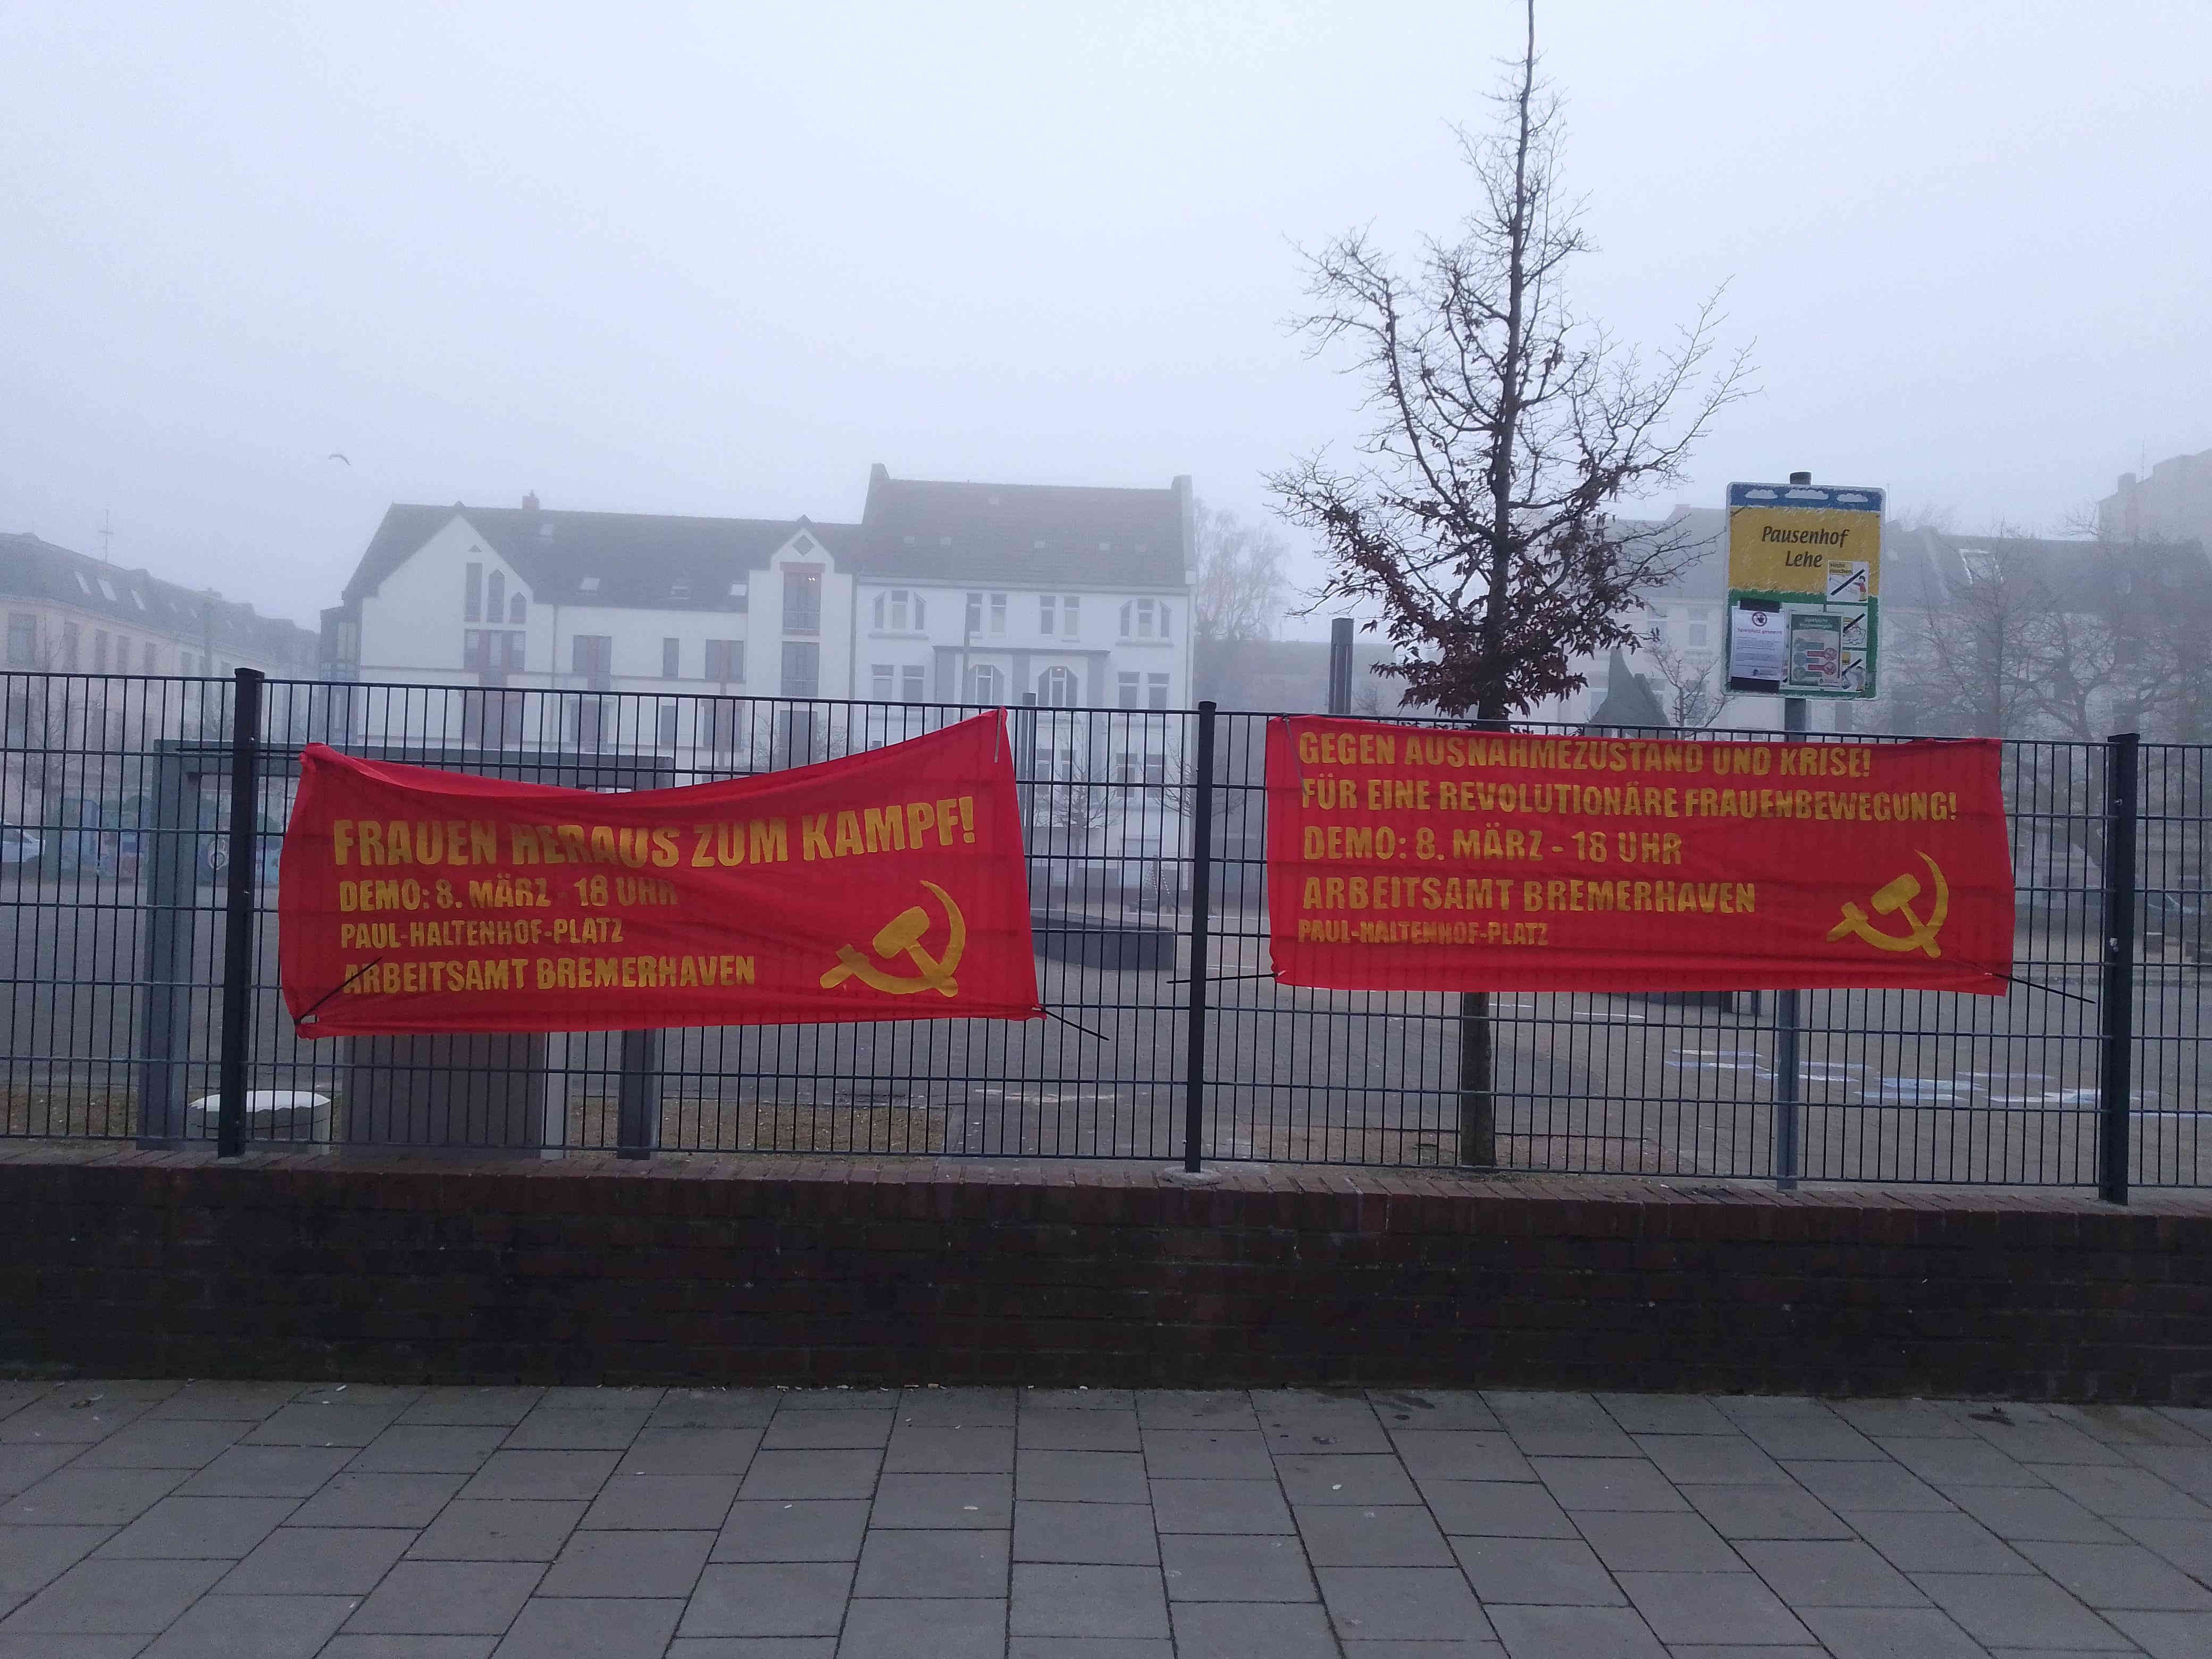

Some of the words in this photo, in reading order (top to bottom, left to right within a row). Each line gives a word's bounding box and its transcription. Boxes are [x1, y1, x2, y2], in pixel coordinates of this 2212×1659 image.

[1761, 526, 1850, 548] Pausenhof
[1785, 551, 1823, 568] Lehe
[1299, 732, 1395, 765] GEGEN
[1405, 736, 1703, 773] AUSNAHMEZUSTAND
[1713, 747, 1772, 775] UND
[1780, 748, 1872, 777] KRISE!
[1302, 773, 1358, 809] FÜR
[1368, 779, 1430, 811] EINE
[1439, 781, 1679, 818] REVOLUTIONÄRE
[1685, 787, 1957, 821] FRAUENBEWEGUNG!
[333, 819, 497, 866] FRAUEN
[511, 824, 680, 868] HERAUS
[691, 816, 789, 867] ZUM
[802, 796, 976, 861] KAMPF!
[1304, 826, 1406, 860] DEMO:
[1415, 827, 1445, 861] 8.
[1453, 822, 1544, 861] MÄRZ
[1572, 831, 1607, 862] 18
[1618, 831, 1682, 865] UHR
[339, 879, 430, 912] DEMO:
[436, 879, 463, 910] 8.
[469, 873, 552, 910] MÄRZ
[574, 875, 608, 908] 18
[616, 879, 679, 907] UHR
[1302, 876, 1514, 911] ARBEITSAMT
[1523, 880, 1756, 913] BREMERHAVEN
[343, 959, 529, 995] ARBEITSAMT
[536, 956, 755, 990] BREMERHAVEN
